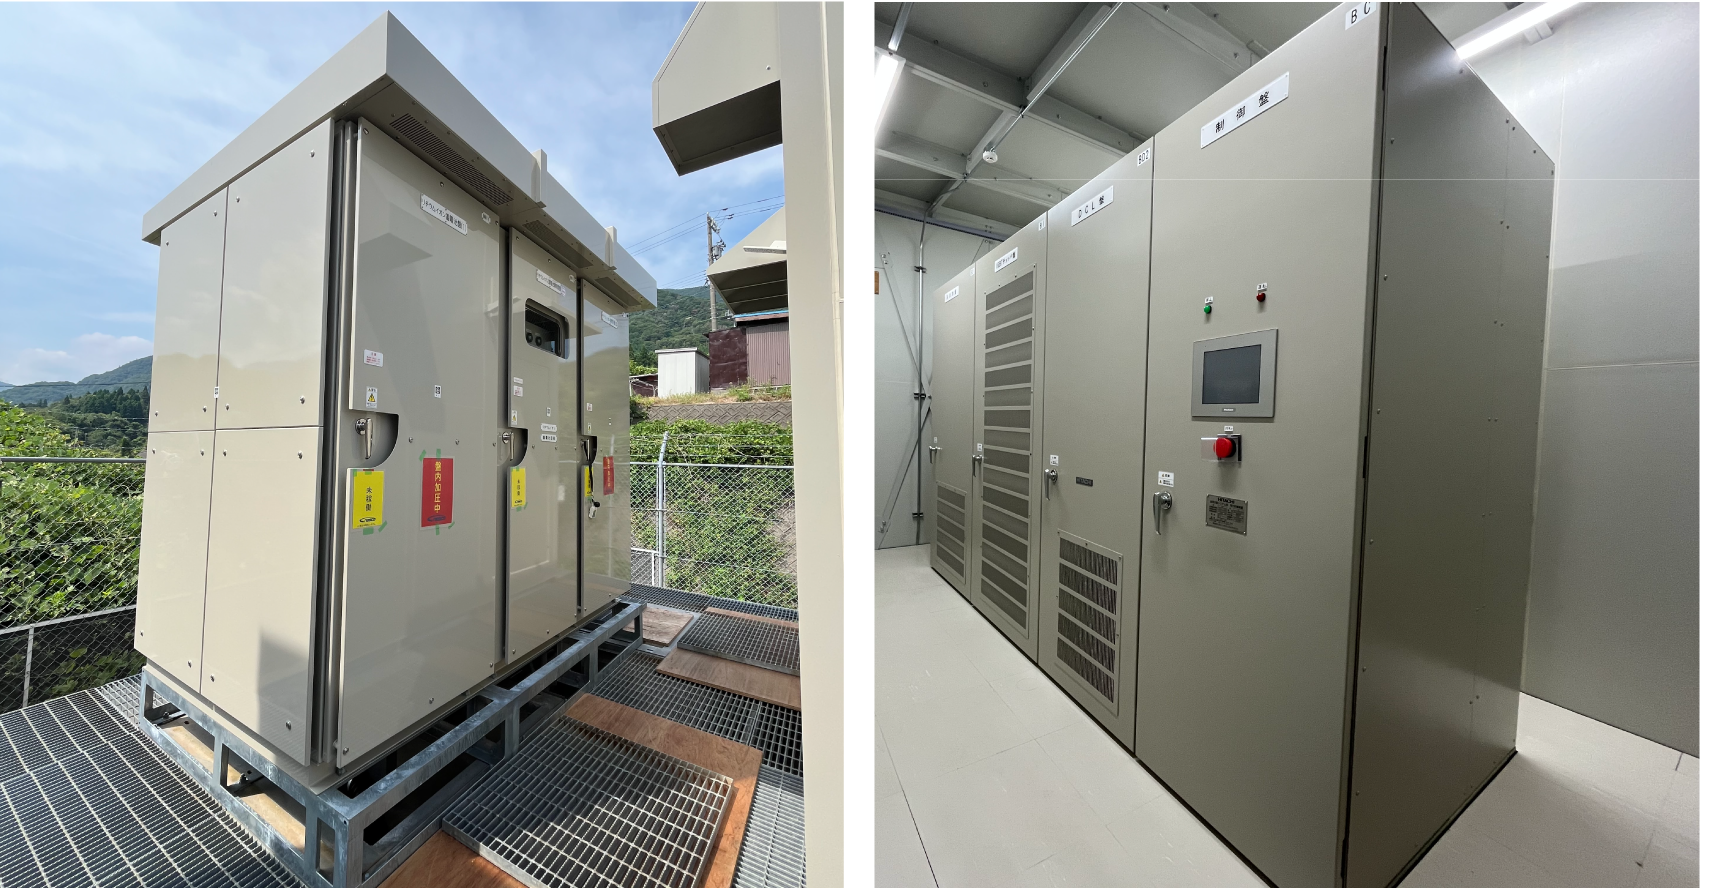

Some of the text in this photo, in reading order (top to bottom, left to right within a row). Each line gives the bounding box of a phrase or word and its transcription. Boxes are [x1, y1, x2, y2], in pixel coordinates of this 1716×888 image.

[1215, 91, 1269, 133] 制御盤
[1138, 150, 1149, 165] BD2
[434, 461, 442, 513] 盤内加圧中
